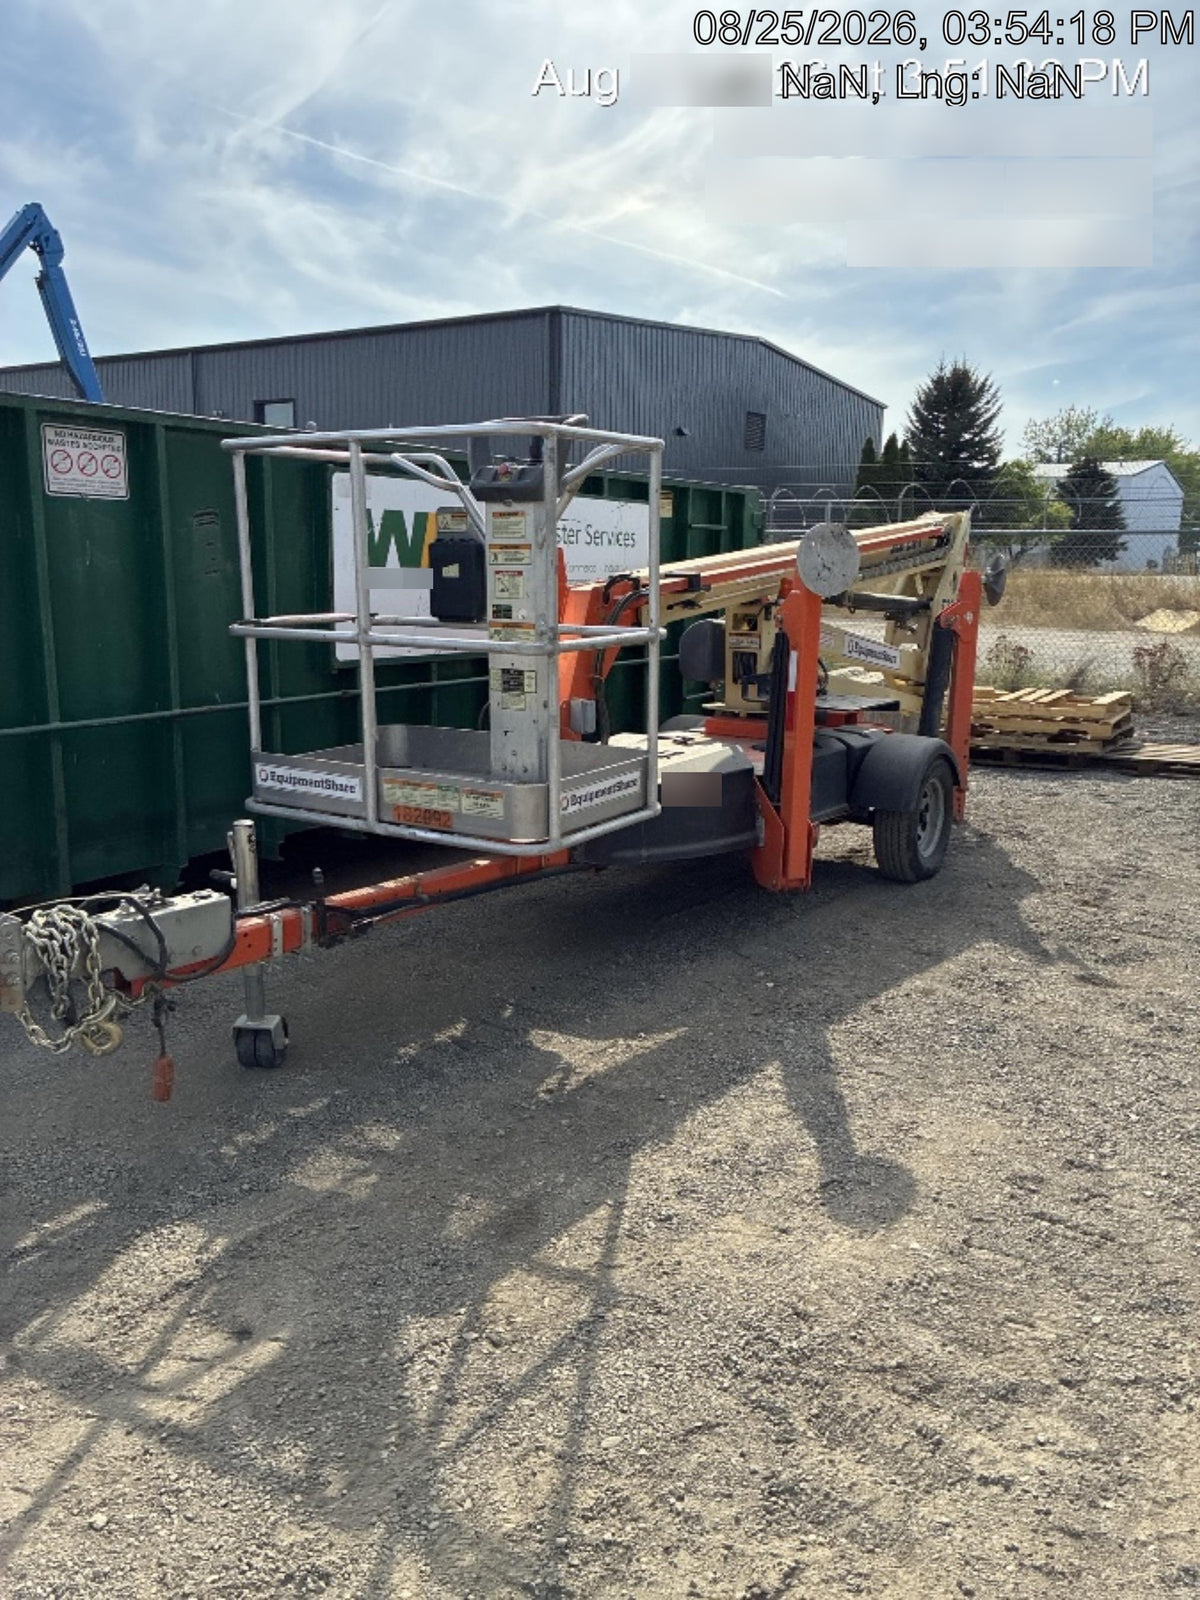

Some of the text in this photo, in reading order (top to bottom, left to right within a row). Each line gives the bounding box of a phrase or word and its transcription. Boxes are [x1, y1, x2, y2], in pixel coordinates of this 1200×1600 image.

[556, 523, 637, 549] ster Services
[269, 770, 357, 795] EquipmentShare
[570, 778, 638, 806] EquipmentShare
